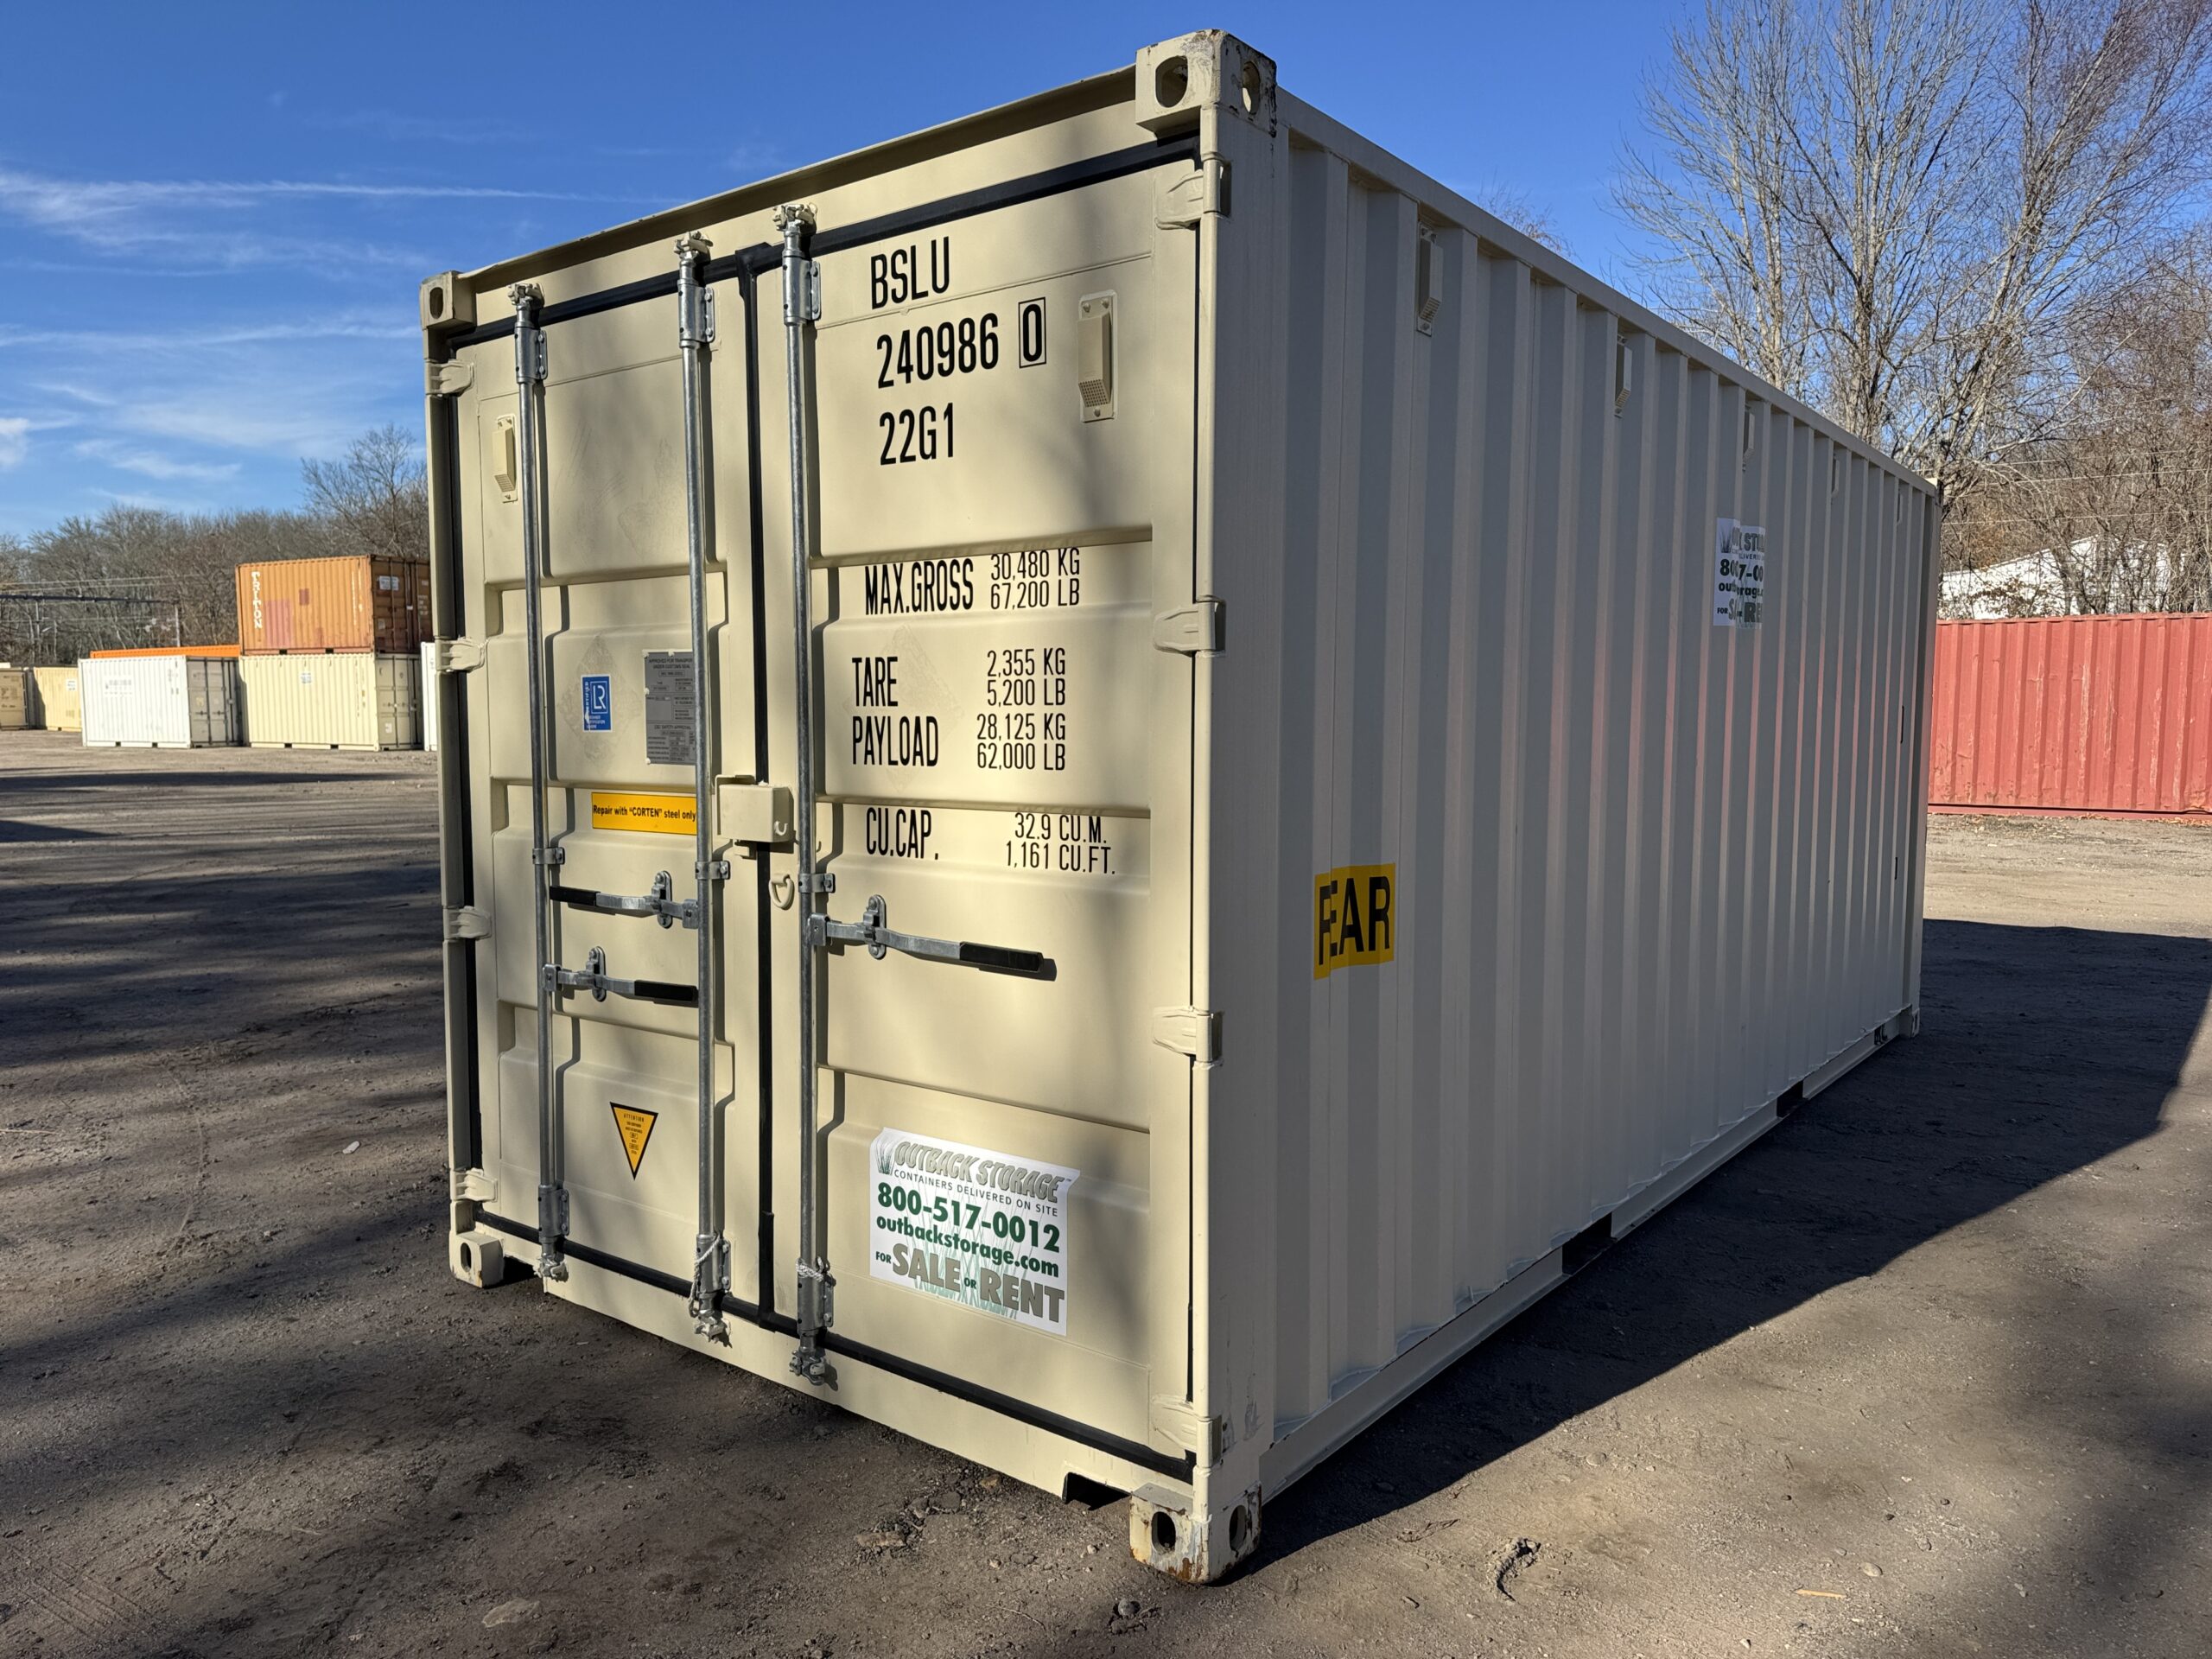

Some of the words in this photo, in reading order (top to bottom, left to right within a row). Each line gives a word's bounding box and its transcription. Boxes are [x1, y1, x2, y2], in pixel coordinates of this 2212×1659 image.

[871, 236, 950, 309] BSLU
[876, 313, 999, 389] 240986
[880, 402, 954, 466] 22G1
[865, 558, 974, 615] MAX.GROSS
[990, 550, 1050, 582] 30,480
[1058, 547, 1081, 576] KG
[990, 580, 1050, 610] 67,200
[1058, 578, 1080, 607] LB
[852, 657, 899, 707] TARE
[987, 649, 1035, 678] 2,355
[1043, 648, 1065, 676] KG
[987, 678, 1035, 708] 5,200
[1043, 677, 1065, 706] LB
[852, 716, 939, 767] PAYLOAD
[977, 713, 1035, 741] 28,125
[1043, 713, 1065, 741] KG
[977, 743, 1035, 771] 62,000
[1043, 743, 1065, 771] LB
[593, 804, 613, 815] Repair
[614, 805, 628, 817] with
[664, 809, 680, 820] steel
[682, 810, 696, 822] only
[1014, 813, 1051, 841] 32.9
[1059, 815, 1107, 844] CU.M.
[1006, 841, 1050, 869] 1,161
[1058, 845, 1116, 874] CU.FT.
[893, 1169, 954, 1191] CONTAINERS
[957, 1185, 1012, 1205] DELIVERED
[1016, 1199, 1031, 1211] ON
[1035, 1205, 1058, 1217] SITE
[894, 1141, 980, 1183] OUTBACK
[976, 1160, 1065, 1204] STORAGE
[876, 1215, 1059, 1278] outbackstorage.com
[878, 1182, 1060, 1253] 800-517-0012
[875, 1251, 892, 1265] FOR
[893, 1243, 961, 1293] SALE
[964, 1277, 977, 1289] OR
[980, 1267, 1065, 1323] RENT
